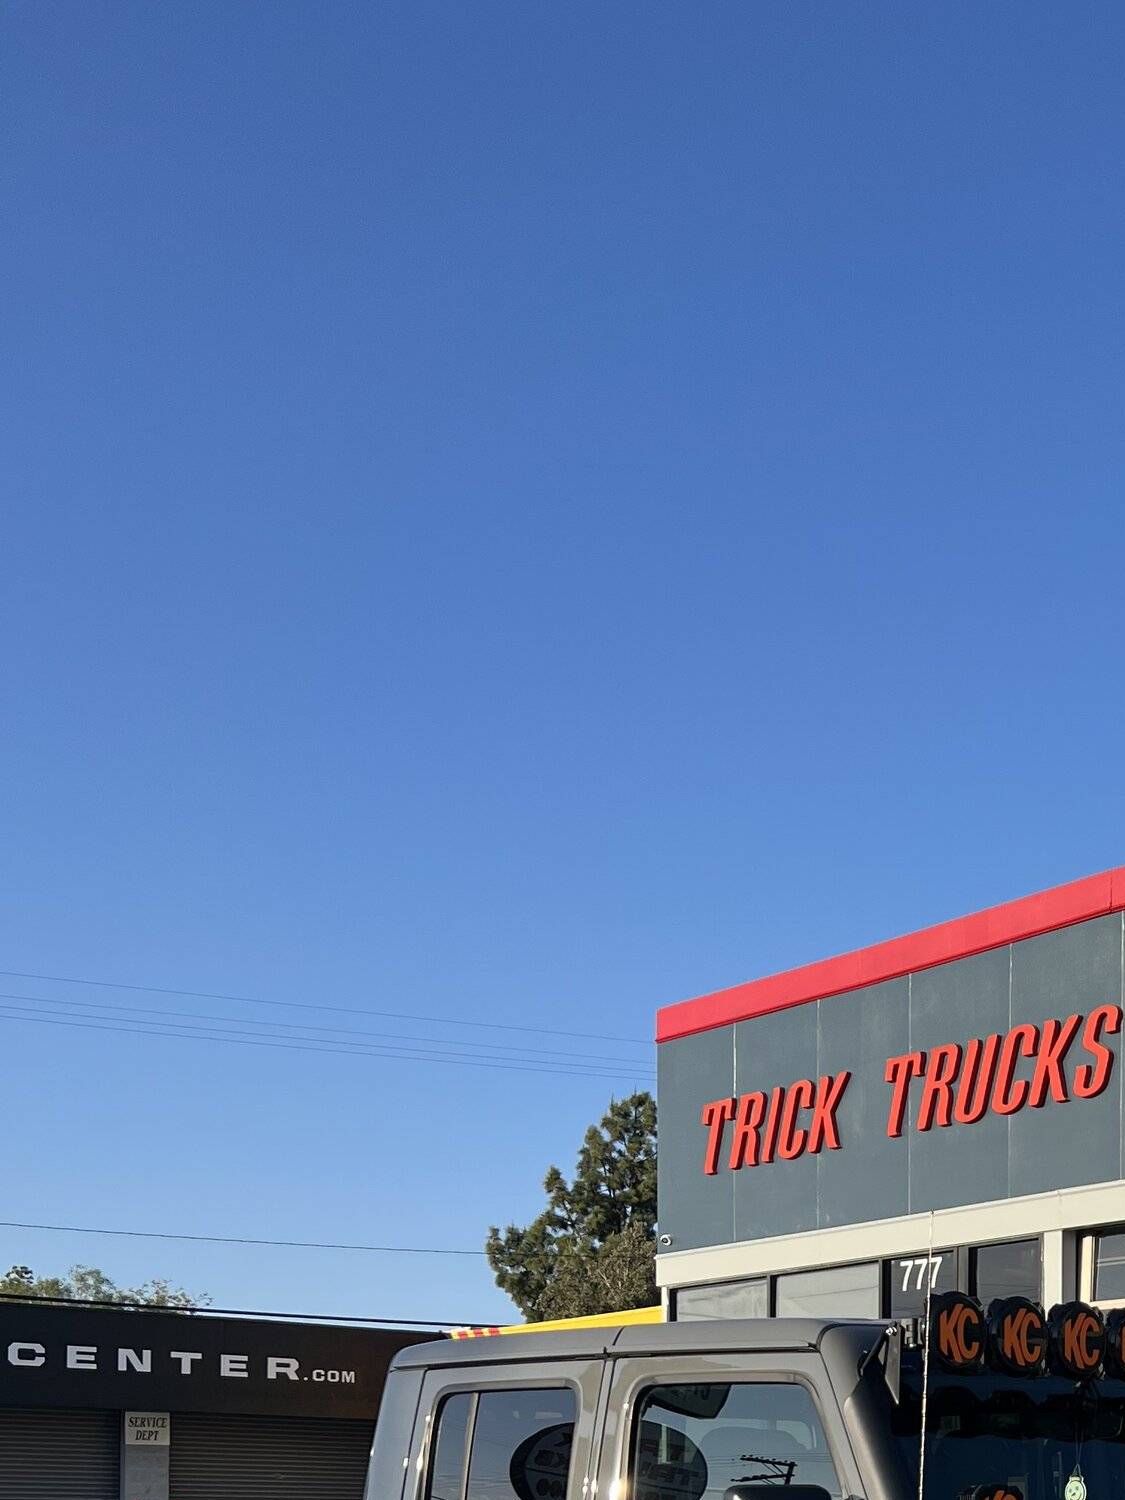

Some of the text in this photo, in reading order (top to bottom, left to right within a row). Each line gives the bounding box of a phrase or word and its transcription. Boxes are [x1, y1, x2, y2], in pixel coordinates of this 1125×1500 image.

[703, 1071, 852, 1176] TRICK
[885, 1004, 1124, 1138] TRUCKS
[900, 1256, 943, 1292] 777
[939, 1303, 980, 1364] KC
[1003, 1308, 1042, 1367] KC
[1064, 1313, 1101, 1370] KC
[128, 1415, 168, 1428] SERVICE
[135, 1430, 160, 1441] DEPT
